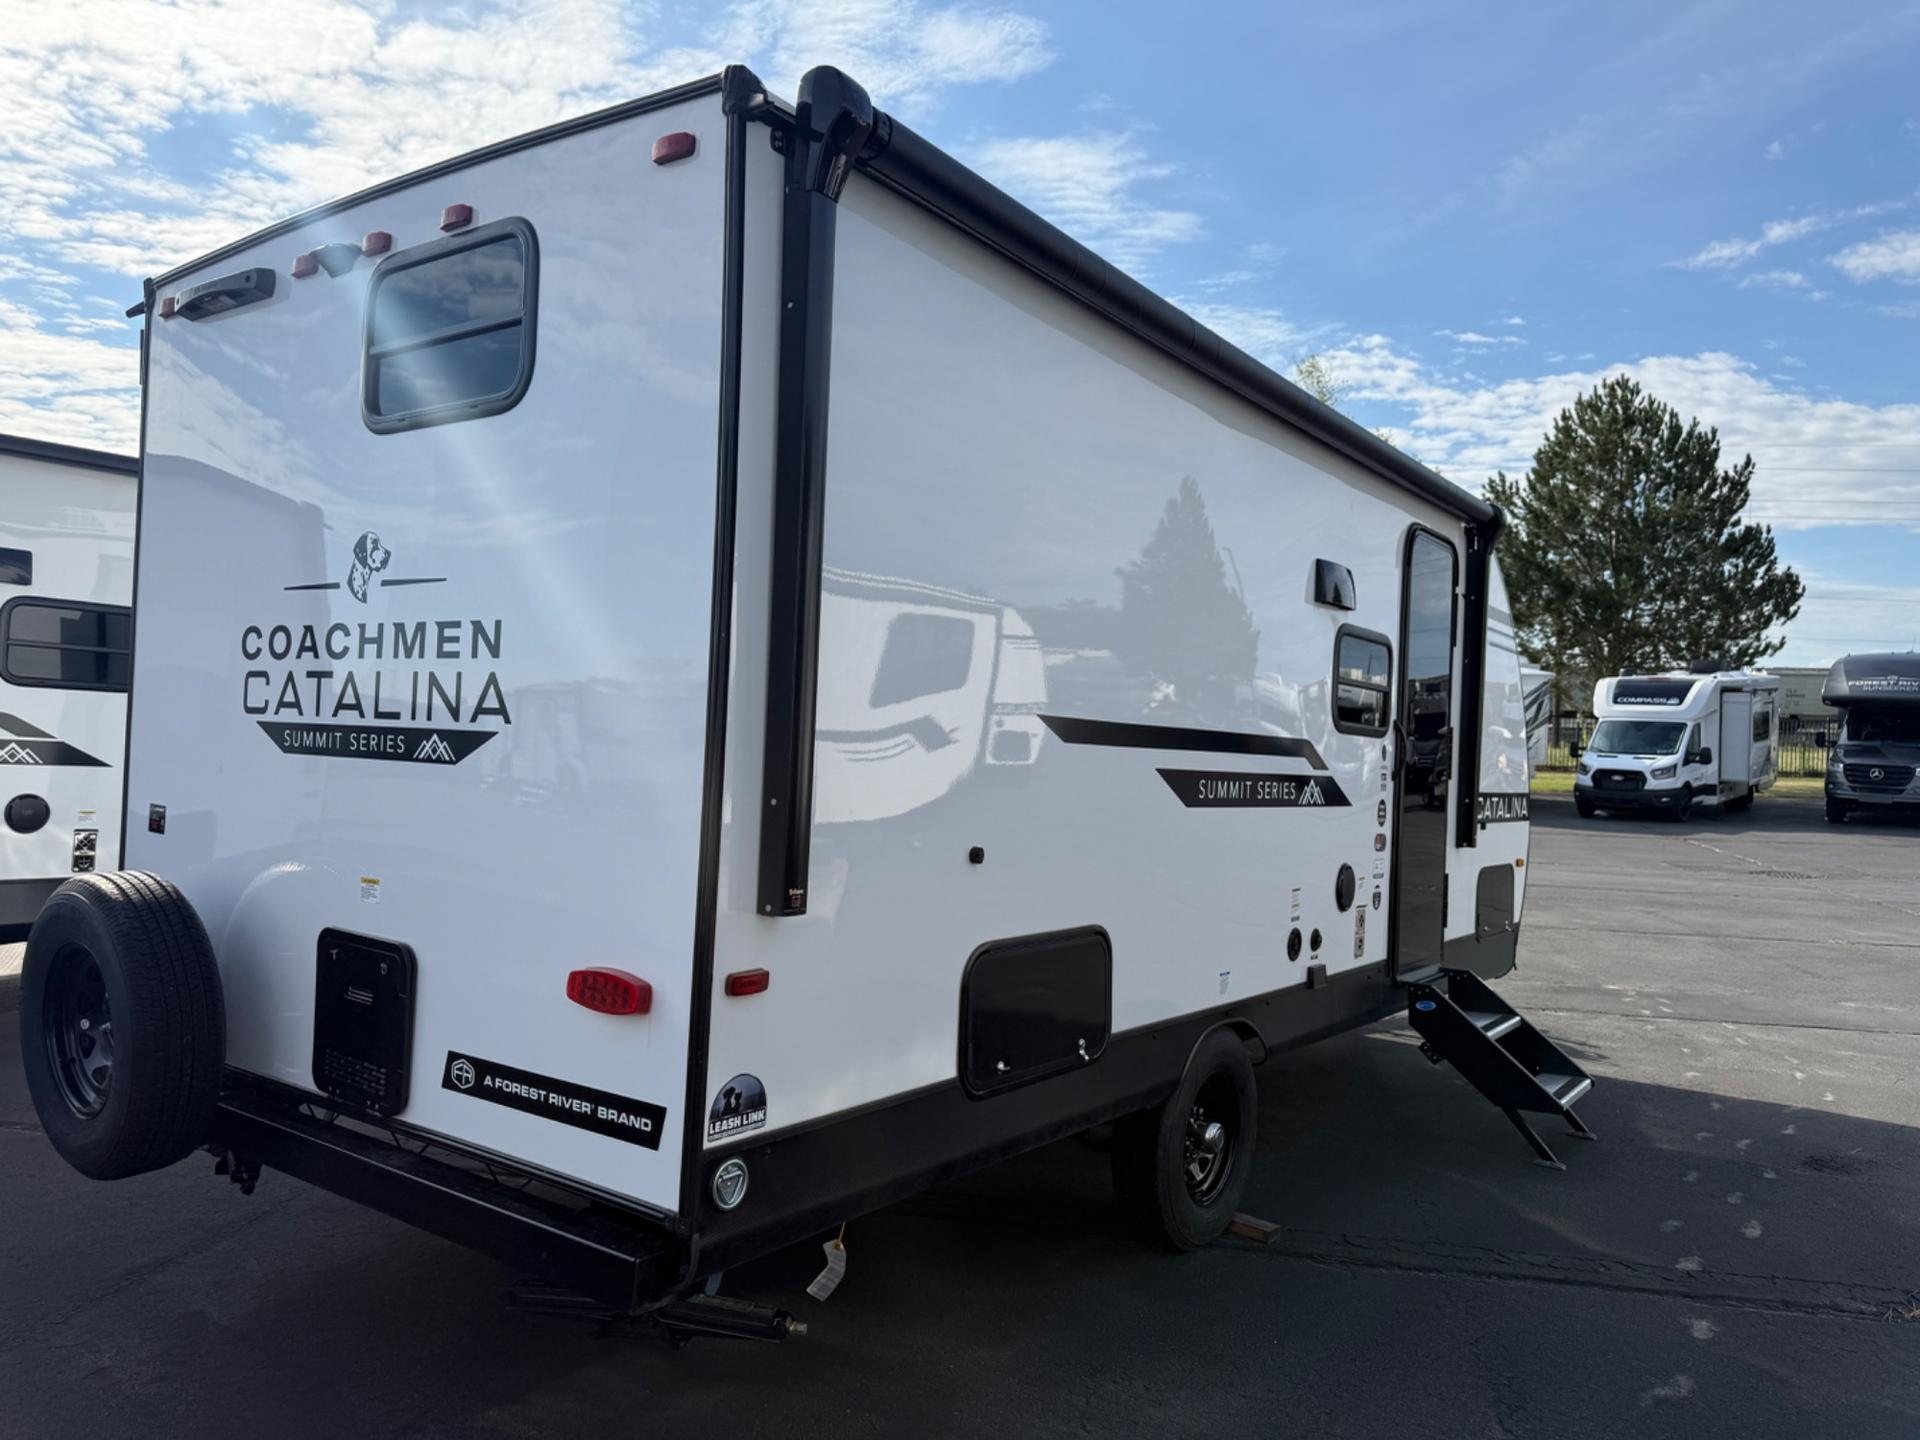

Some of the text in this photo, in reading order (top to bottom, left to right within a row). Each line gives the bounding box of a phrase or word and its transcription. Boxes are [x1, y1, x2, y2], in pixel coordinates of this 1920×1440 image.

[241, 619, 502, 661] COACHMEN
[243, 670, 512, 725] CATALINA
[1617, 696, 1667, 704] COMPASS
[283, 729, 406, 754] SUMMIT SERIES
[1198, 779, 1296, 800] SUMMIT SERIES
[483, 1074, 494, 1087] A
[494, 1077, 547, 1102] FOREST
[597, 1106, 652, 1132] BRAND
[709, 1115, 742, 1135] LEASH
[742, 1109, 765, 1125] LINK
